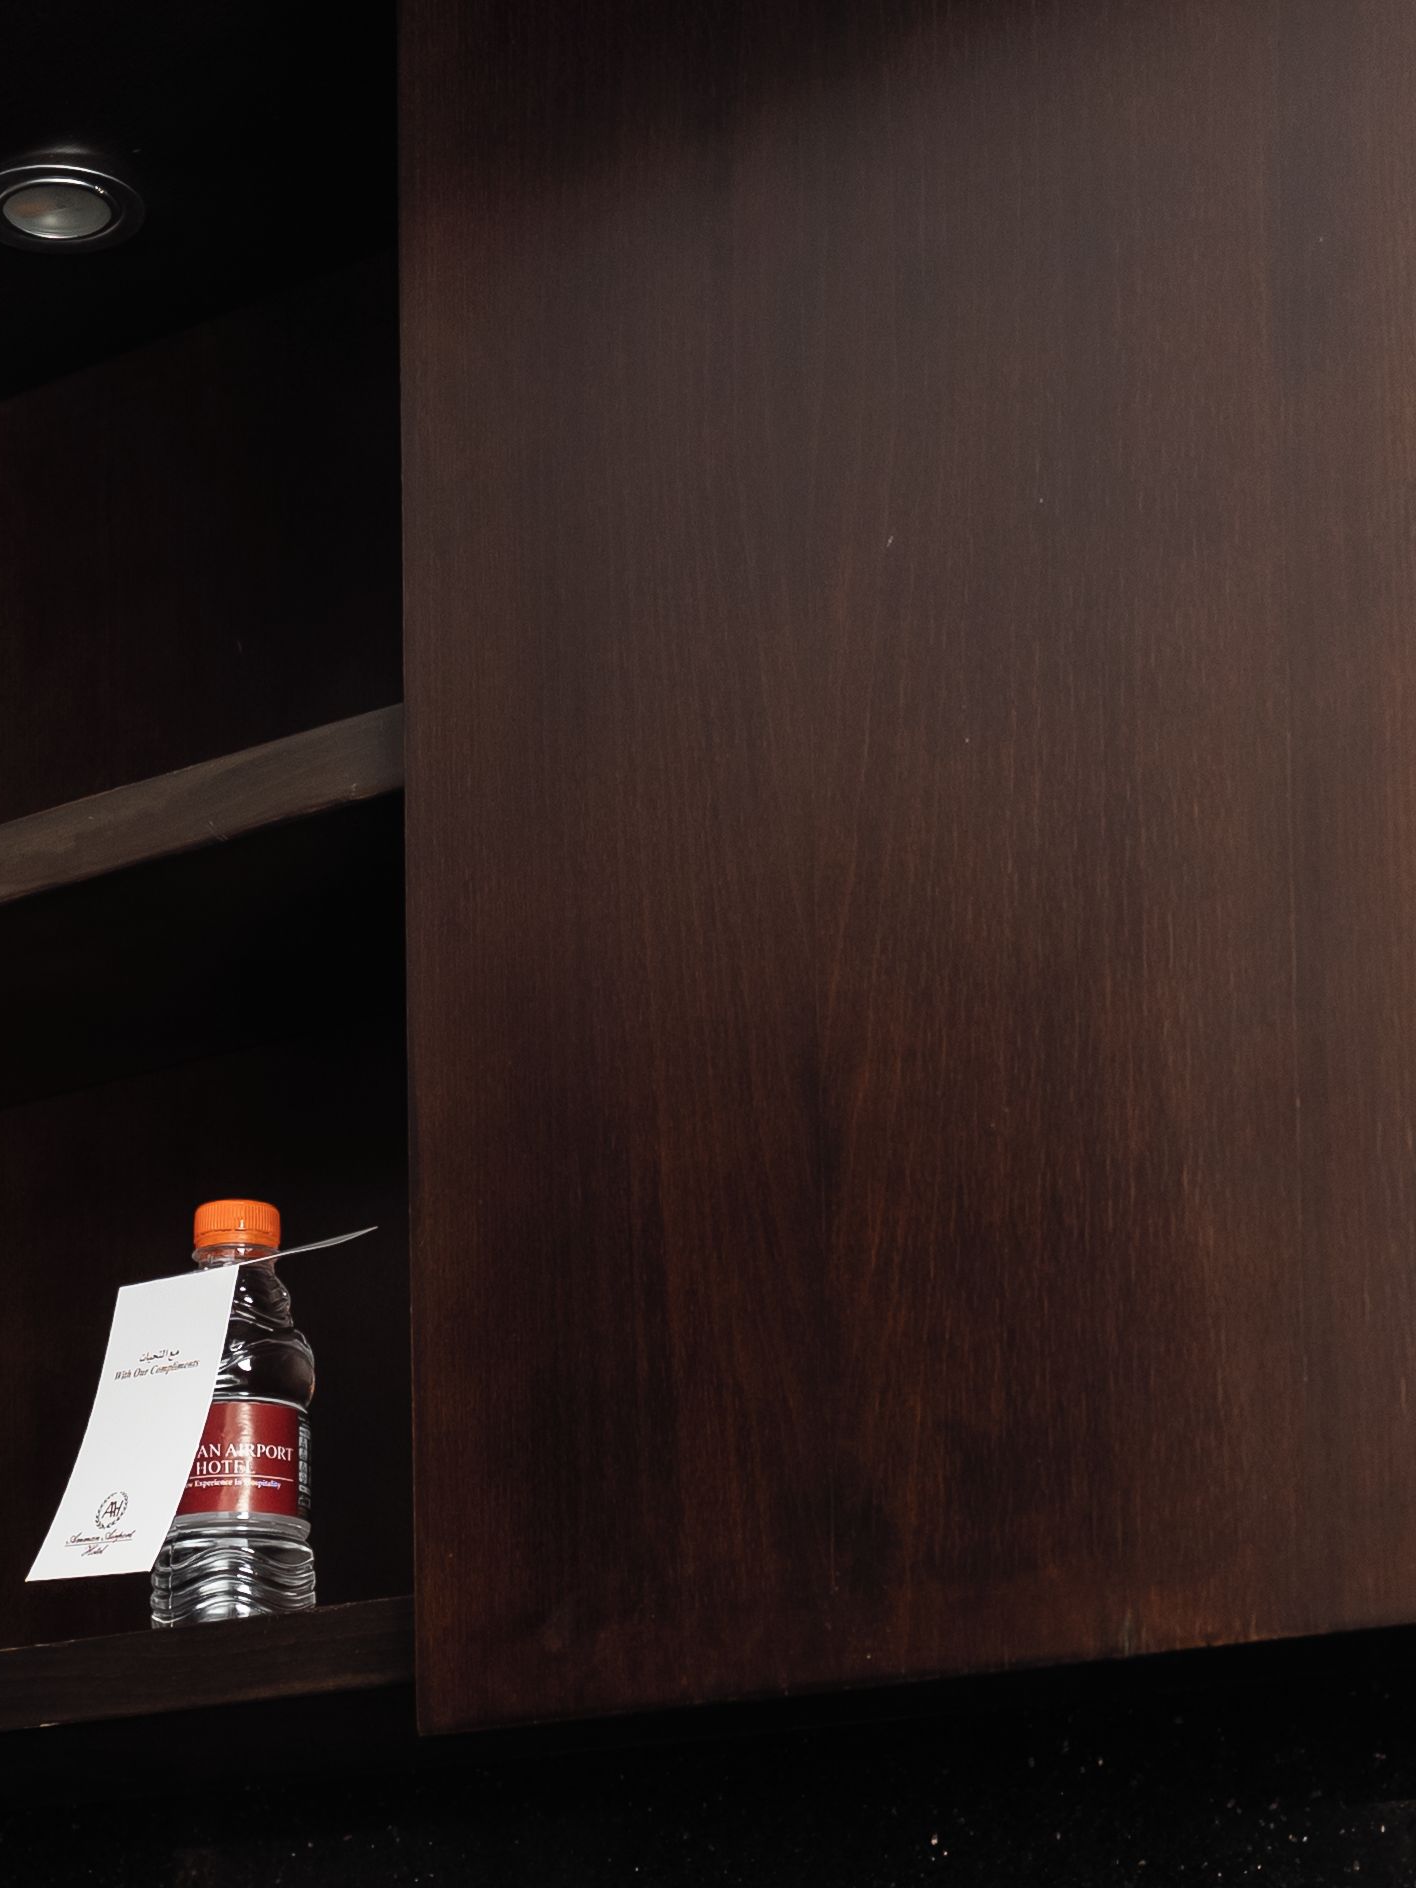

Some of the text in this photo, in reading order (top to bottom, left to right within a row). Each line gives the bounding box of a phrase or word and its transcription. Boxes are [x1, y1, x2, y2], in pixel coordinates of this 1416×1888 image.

[114, 1358, 201, 1381] With Our Compliments
[224, 1443, 294, 1462] AIRPORT
[196, 1459, 256, 1476] HOTEL
